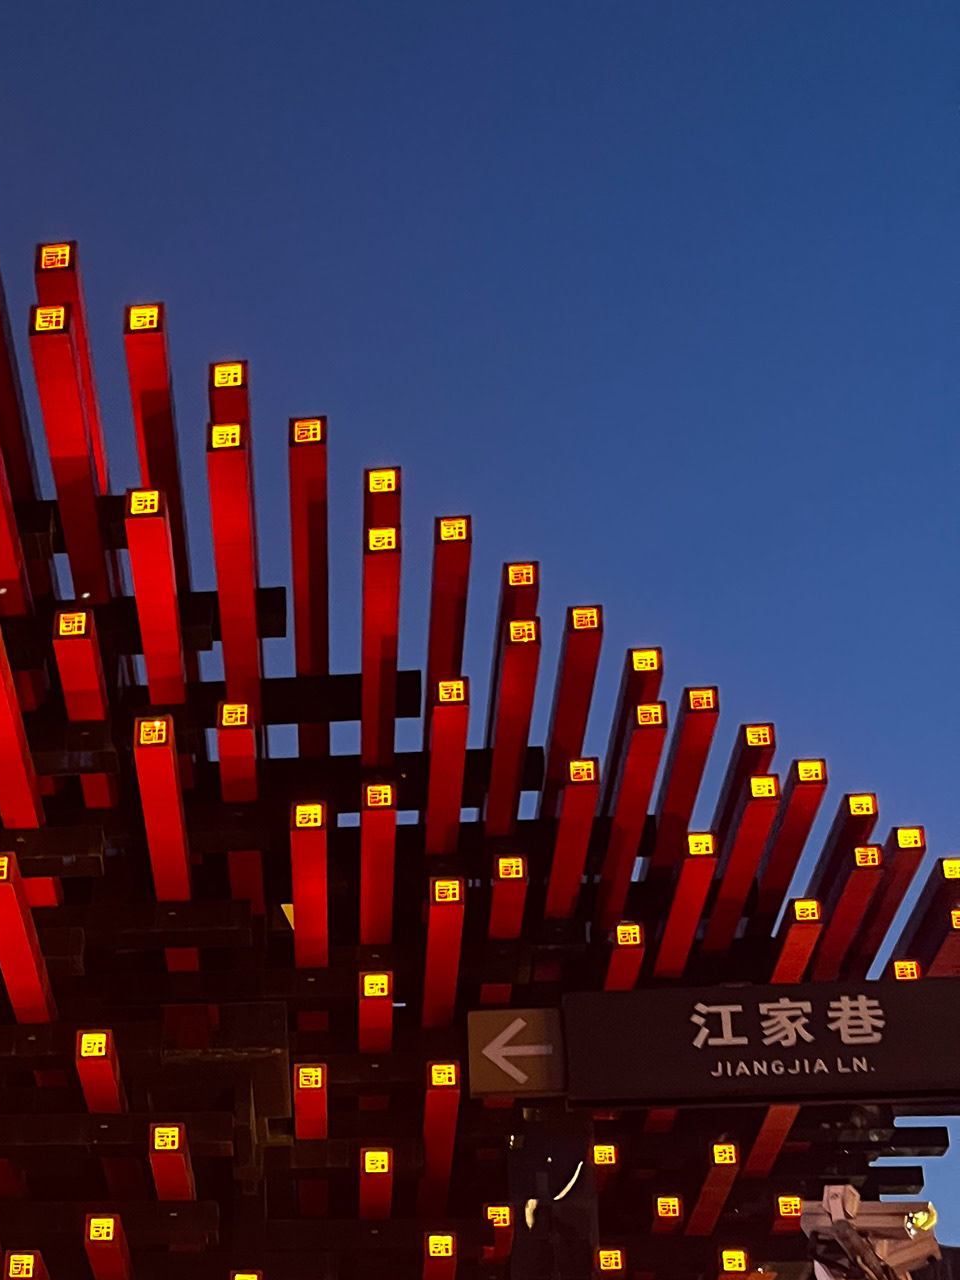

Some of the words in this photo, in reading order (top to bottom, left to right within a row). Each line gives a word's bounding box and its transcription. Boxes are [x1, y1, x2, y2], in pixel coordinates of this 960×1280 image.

[690, 994, 886, 1049] 江家巷
[710, 1058, 829, 1077] JIANGJIA
[837, 1056, 876, 1074] LN.
